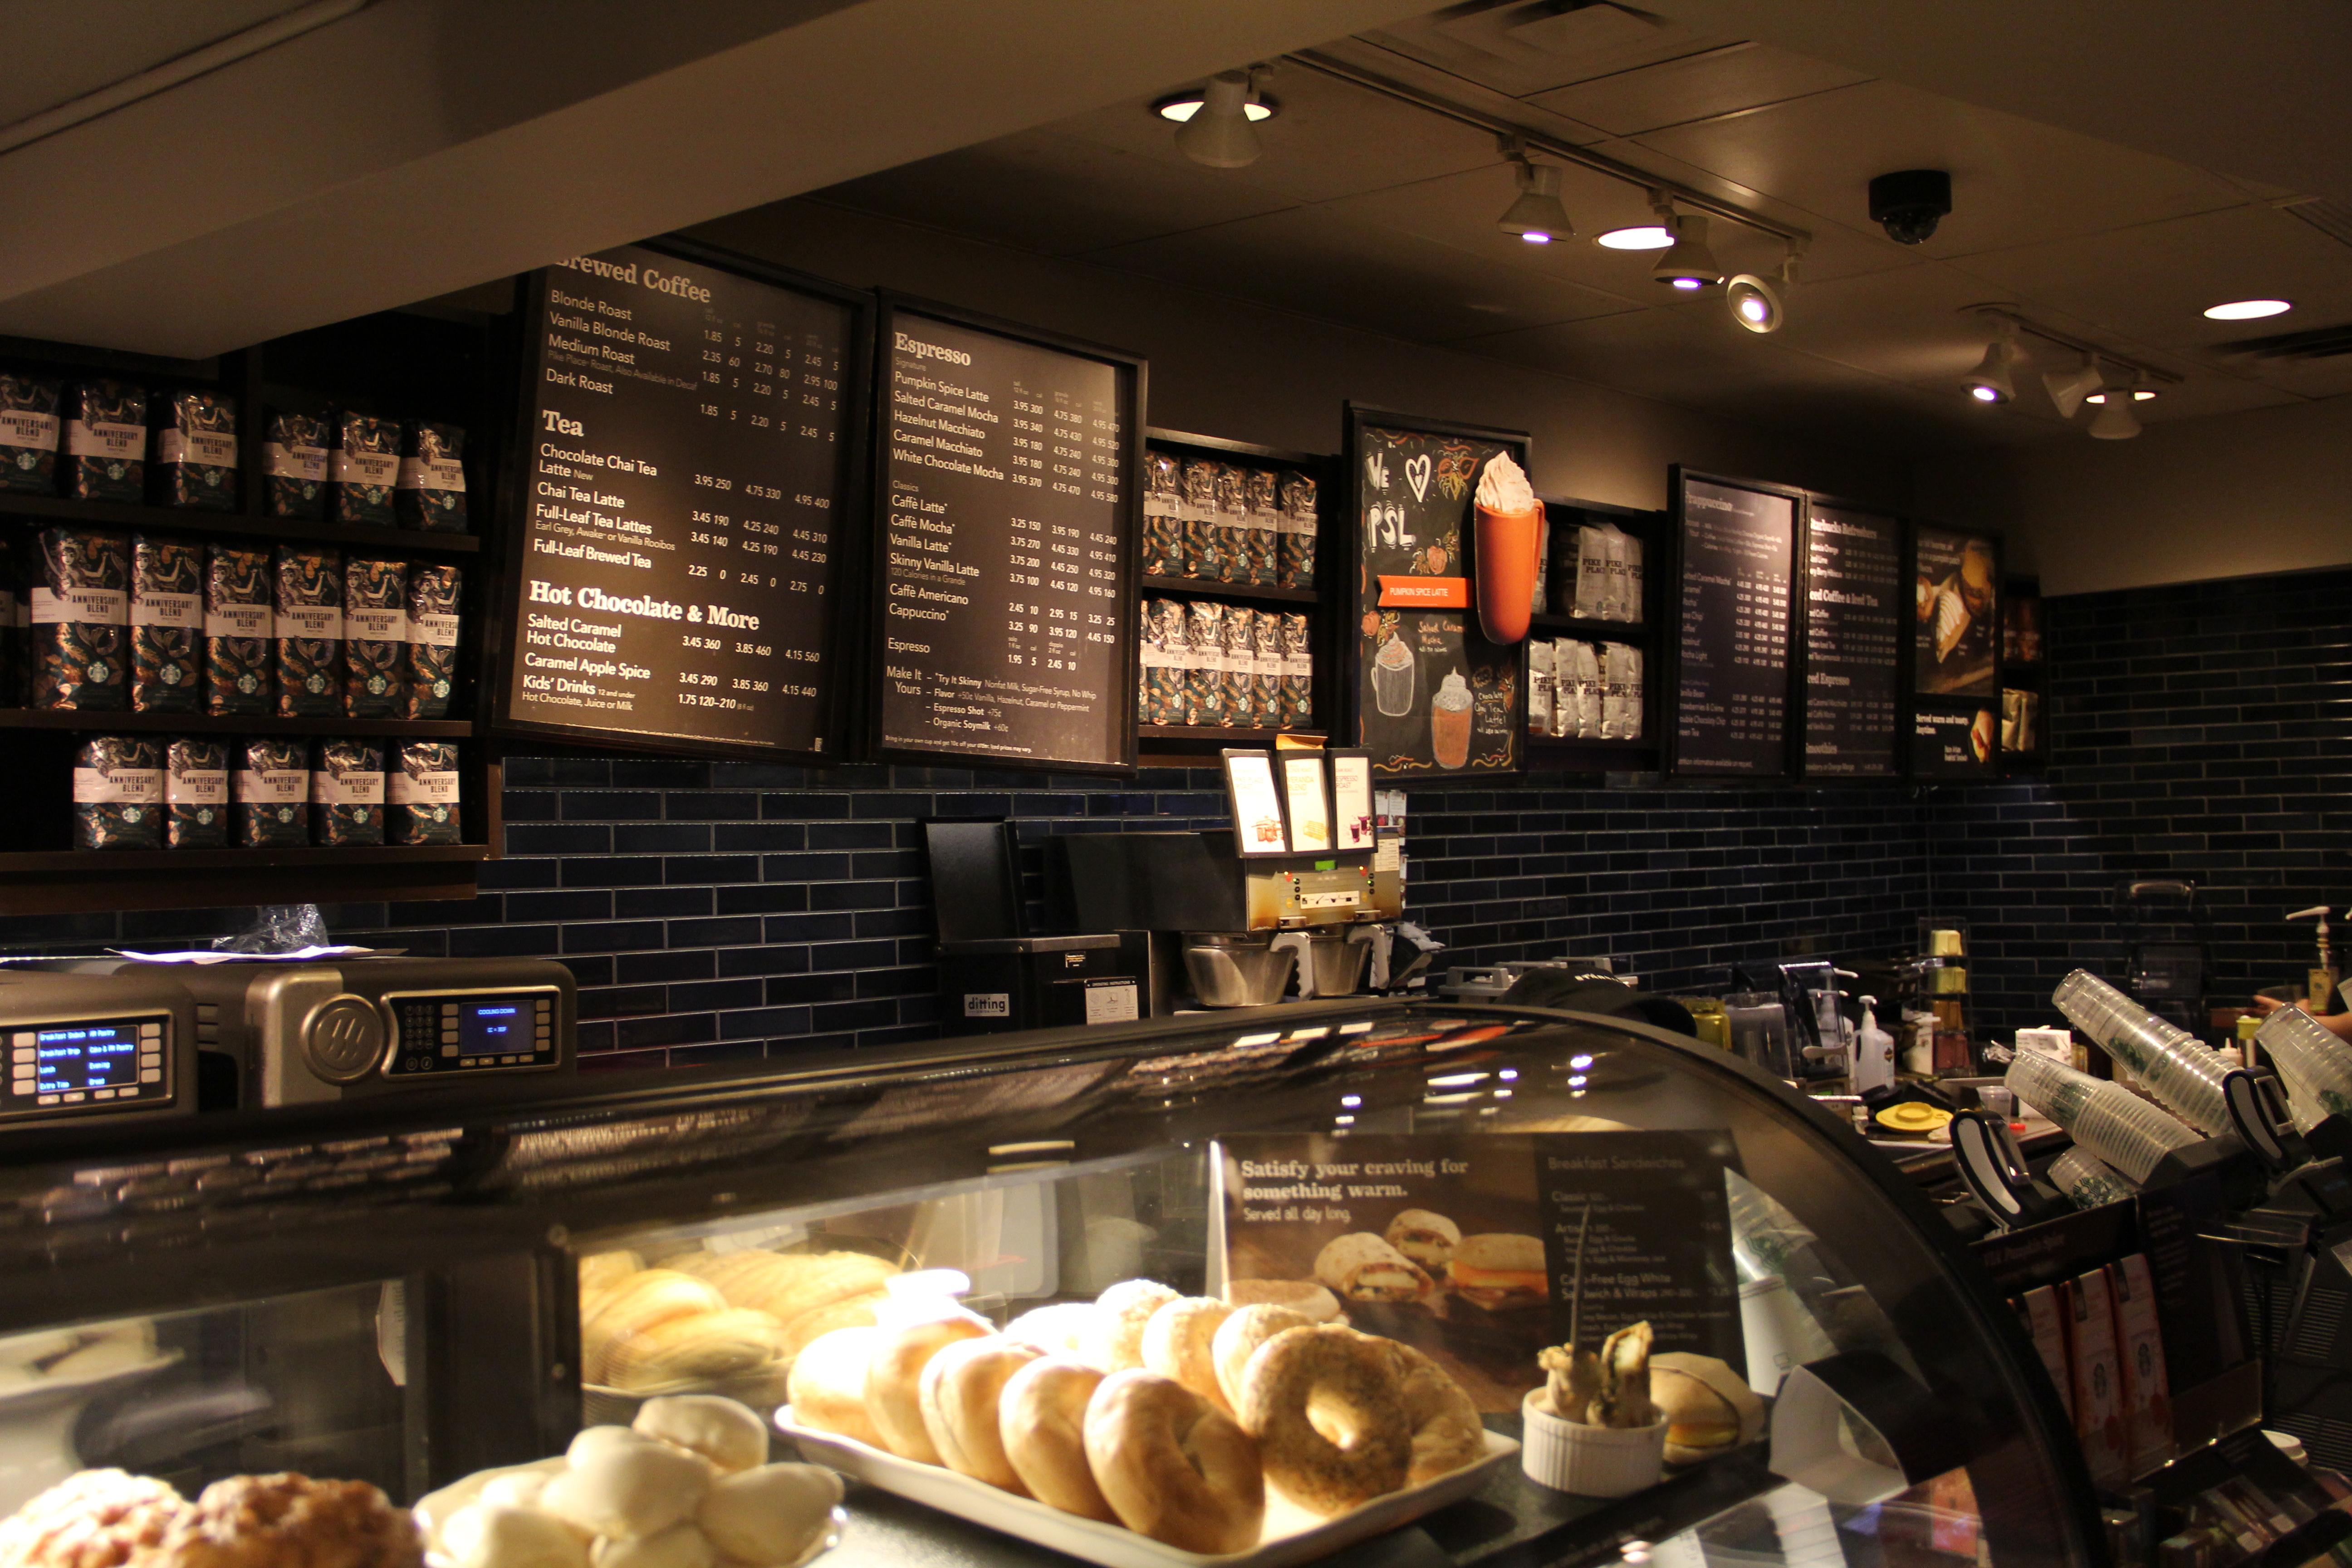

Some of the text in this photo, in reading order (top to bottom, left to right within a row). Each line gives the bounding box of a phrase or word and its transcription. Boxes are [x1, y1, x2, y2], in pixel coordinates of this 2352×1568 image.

[643, 269, 711, 303] Coffee
[551, 289, 632, 321] Blonde Roast
[549, 311, 671, 352] Vanilla Blonde Roast
[549, 333, 635, 365] Medium Roast
[895, 332, 971, 366] Espresso
[896, 357, 926, 372] Signature
[546, 368, 613, 394] Dark Roast
[895, 371, 990, 402] Pumpkin Spice Latte
[894, 390, 999, 423] Salted Caramel Mocha
[543, 410, 584, 437] Tea
[894, 410, 985, 439] Hazelnut Macchiato
[893, 429, 983, 457] Caramel Macchiato
[539, 459, 593, 480] Latte New
[540, 443, 657, 476] Chocolate Chai Tea
[893, 448, 1004, 480] White Chocolate Mocha
[892, 480, 919, 492] Classics
[537, 481, 827, 544] Chai Tea Latte 3.45 190 4.25 240 4.45 310
[892, 494, 918, 510] Caffè
[536, 503, 652, 535] Full-Leaf Tea Lattes
[891, 514, 917, 529] Caffè
[1367, 501, 1416, 551] PSL
[535, 519, 552, 531] Earl
[553, 523, 575, 537] Grey,
[617, 533, 643, 545] Vanilla
[644, 537, 676, 551] Rooibos
[890, 533, 922, 549] Vanilla
[534, 538, 652, 568] Full-Leaf Brewed Tea
[890, 552, 980, 577] Skinny Vanilla Latte
[72, 595, 119, 606] ANNIVERSARY
[1390, 587, 1448, 597] PUMPKIN SPICE LATTE
[87, 604, 109, 613] BLEND
[529, 580, 760, 631] Hot Chocolate & More
[890, 583, 1115, 626] Caffè Americano 2.45 10 2.95 15 3.25 25
[356, 615, 397, 623] ANNIVERSARY
[527, 613, 622, 637] Salted Caramel
[526, 630, 616, 653] Hot Chocolate
[888, 637, 931, 653] Espresso
[524, 652, 651, 680] Caramel Apple Spice
[523, 674, 596, 695] Kids' Drinks
[887, 665, 912, 680] Make
[915, 668, 922, 681] It
[951, 676, 957, 684] It
[958, 676, 982, 689] Skinny
[895, 681, 921, 695] Yours
[934, 688, 955, 698] Flavor
[522, 691, 539, 702] Hot
[539, 692, 583, 707] Chocolate,
[584, 697, 606, 708] Juice
[616, 700, 633, 711] Milk
[934, 702, 985, 715] Espresso Shot
[933, 717, 991, 731] Organic Soymilk
[109, 776, 155, 784] ANNIVERSARY
[968, 997, 1005, 1012] ditting
[40, 1033, 66, 1041] Breakfast
[40, 1049, 66, 1058] Breakfast
[116, 1044, 134, 1052] Pastry
[40, 1065, 56, 1074] Lunch
[89, 1061, 111, 1070] Evening
[40, 1081, 70, 1090] Extra Time
[89, 1077, 105, 1086] Bread
[1241, 1158, 1469, 1180] Satisfy your craving for
[1243, 1182, 1408, 1202] something warm.
[1243, 1205, 1352, 1224] Served all day long.
